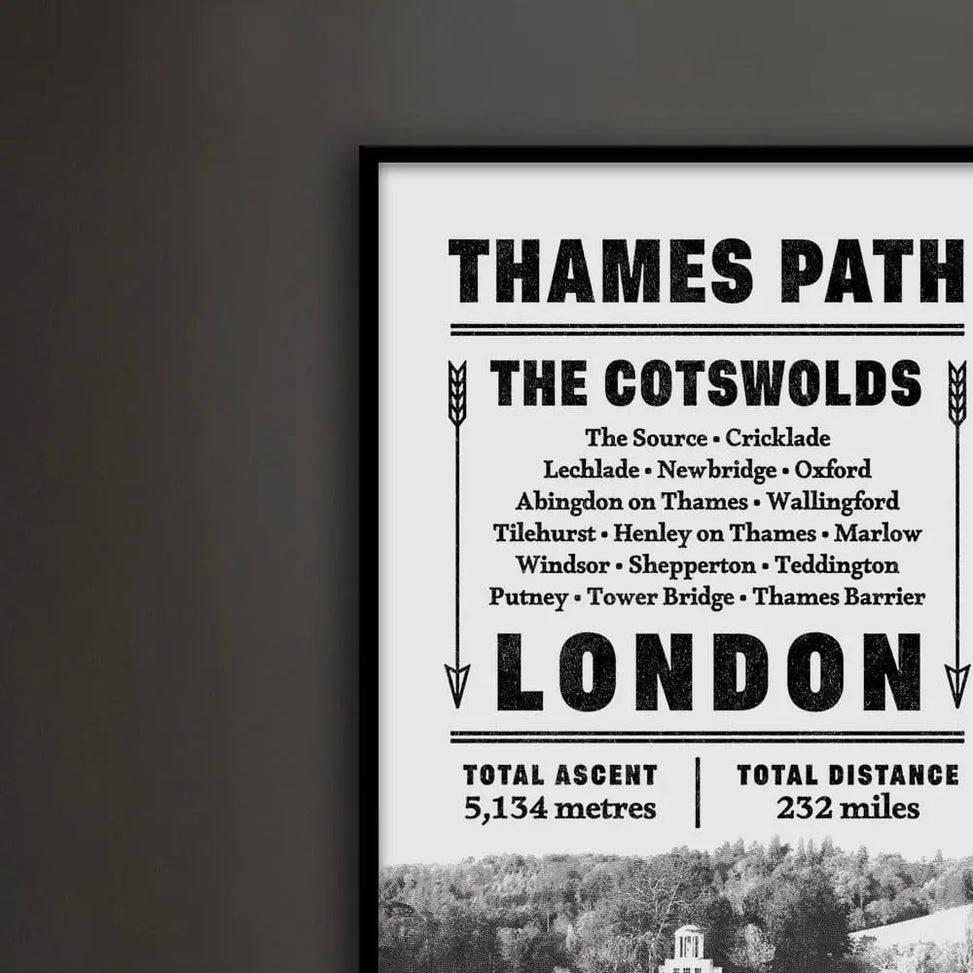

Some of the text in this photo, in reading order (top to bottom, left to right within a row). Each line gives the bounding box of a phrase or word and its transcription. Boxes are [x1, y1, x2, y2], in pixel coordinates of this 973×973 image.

[448, 237, 965, 305] THAMES PATH
[489, 359, 922, 407] THE COTSWOLDS
[584, 426, 831, 448] The Source Cricklade
[543, 458, 873, 484] Lechlade Newbridge Oxford
[514, 489, 901, 516] Abingdon on Thames Wallingford
[492, 521, 923, 549] Tilehurst Henley on Thames Marlow
[514, 553, 900, 581] Windsor Shepperton Teddington
[488, 585, 926, 611] Putney Tower Bridge Thames Barrier
[496, 631, 921, 713] LONDON
[462, 763, 658, 786] TOTAL ASCENT
[736, 763, 959, 786] TOTAL DISTANCE
[464, 795, 657, 826] 5,134 metres
[776, 791, 921, 820] 232 miles
